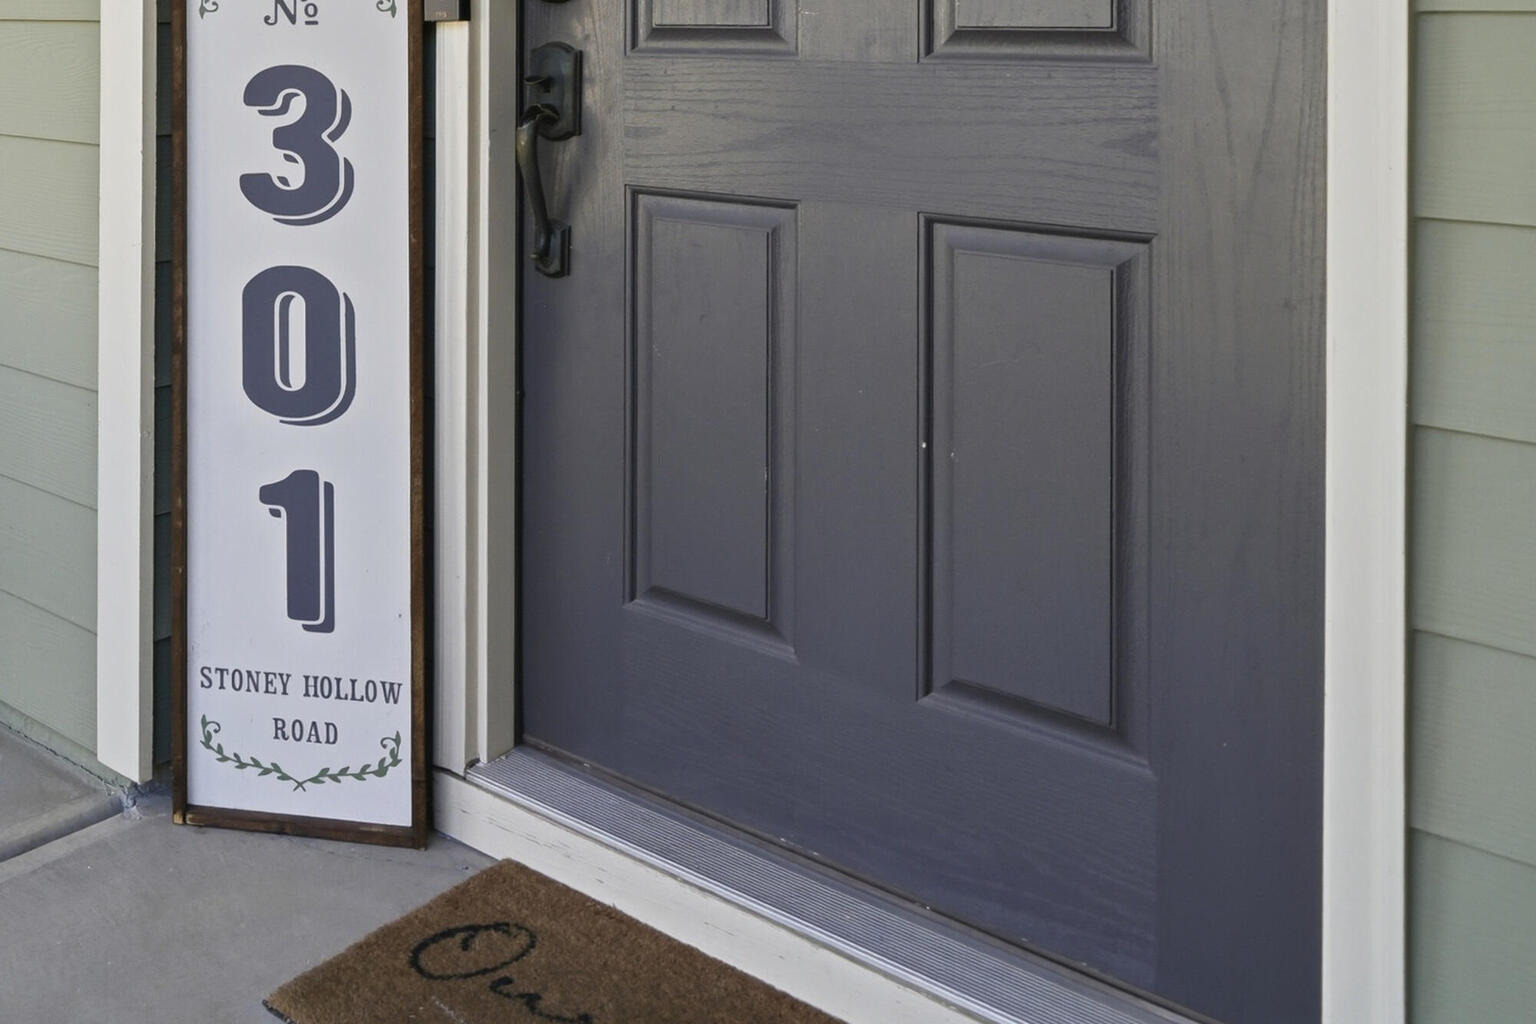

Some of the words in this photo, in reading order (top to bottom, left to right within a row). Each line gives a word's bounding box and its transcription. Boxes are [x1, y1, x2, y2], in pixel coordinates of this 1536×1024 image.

[200, 666, 292, 696] STONEY
[303, 674, 403, 705] HOLLOW
[272, 717, 339, 745] ROAD
